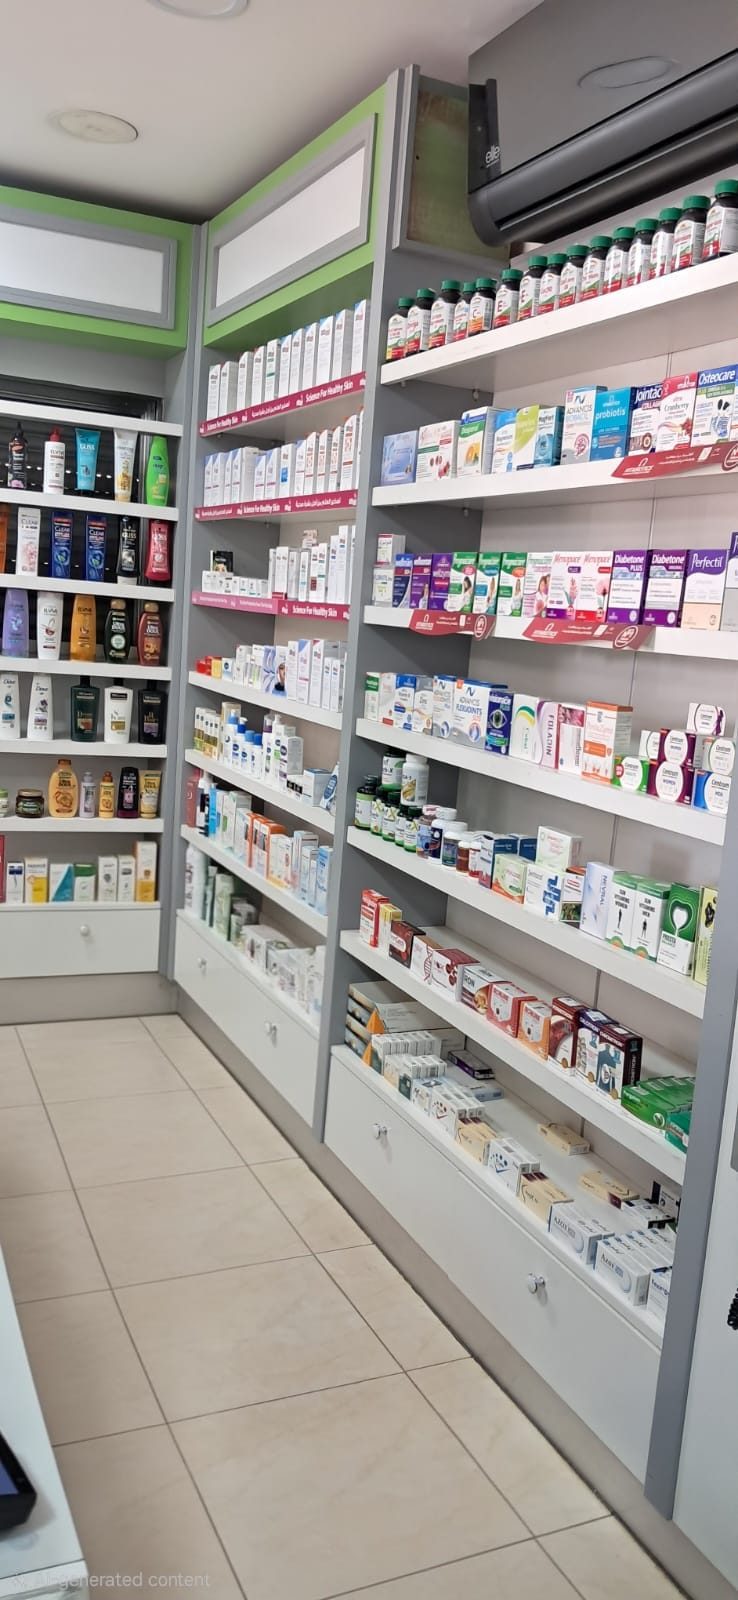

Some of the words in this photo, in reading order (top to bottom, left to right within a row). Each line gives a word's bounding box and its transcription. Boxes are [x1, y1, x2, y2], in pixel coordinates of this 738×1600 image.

[699, 370, 736, 385] Osteocare
[635, 387, 662, 403] Jointac
[664, 401, 689, 411] Cranberry
[614, 554, 644, 564] Diabetone
[651, 554, 685, 564] Diabetone
[691, 553, 723, 571] Perfectil
[712, 779, 729, 788] Centrum
